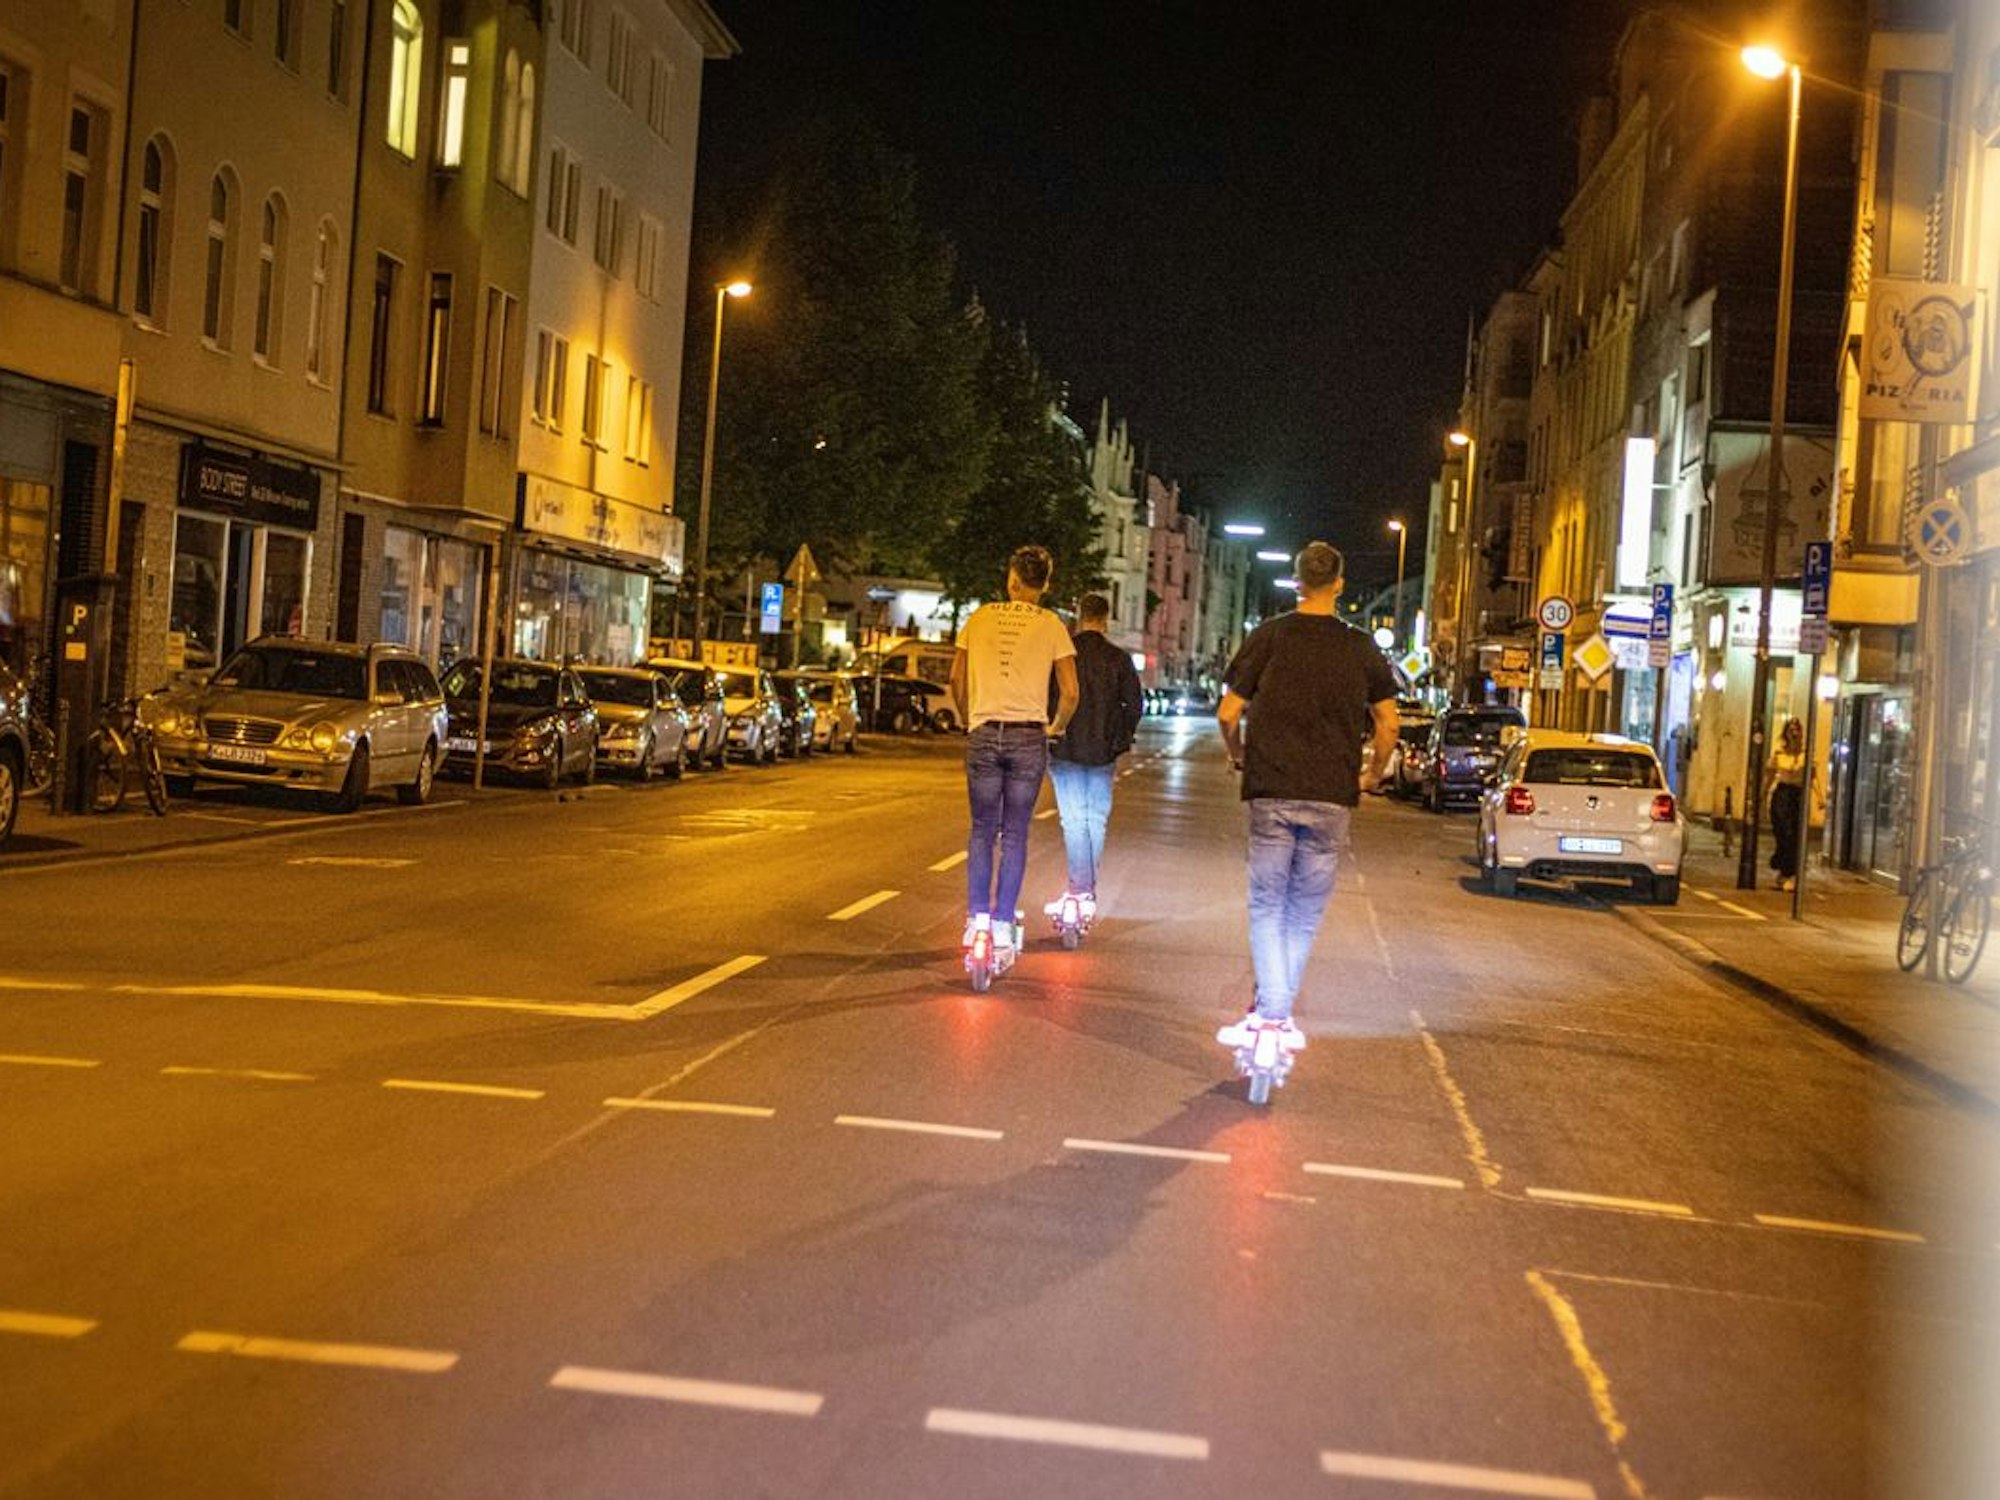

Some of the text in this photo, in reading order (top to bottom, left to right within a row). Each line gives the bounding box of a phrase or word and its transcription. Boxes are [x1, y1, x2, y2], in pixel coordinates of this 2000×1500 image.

[1807, 545, 1822, 575] P
[1655, 586, 1666, 601] P
[73, 604, 88, 626] P
[1546, 604, 1567, 622] 30
[1543, 634, 1556, 651] P
